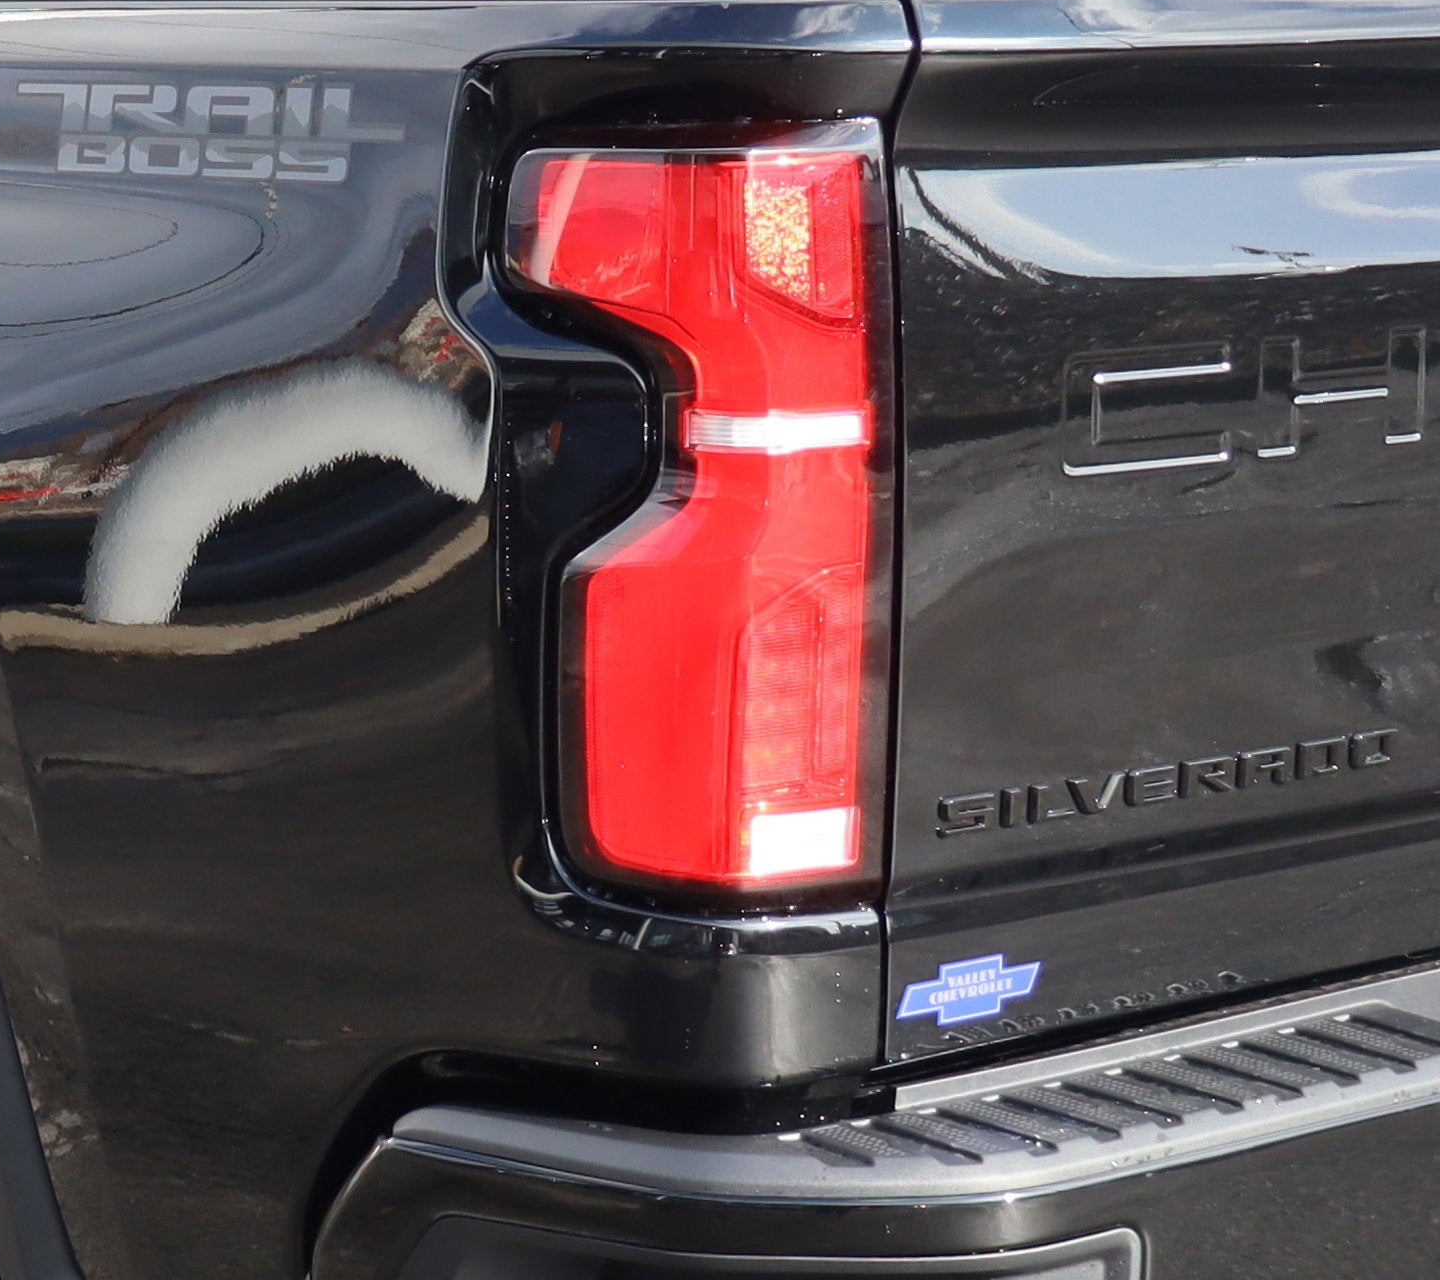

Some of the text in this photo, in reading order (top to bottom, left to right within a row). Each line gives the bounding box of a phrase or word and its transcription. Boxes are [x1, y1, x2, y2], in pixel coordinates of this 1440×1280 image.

[18, 82, 406, 142] TRAIL
[56, 133, 349, 183] BOSS
[934, 727, 1400, 839] SILVERADO
[928, 977, 1014, 1006] CHEVROLET
[947, 968, 997, 988] VALLEY
